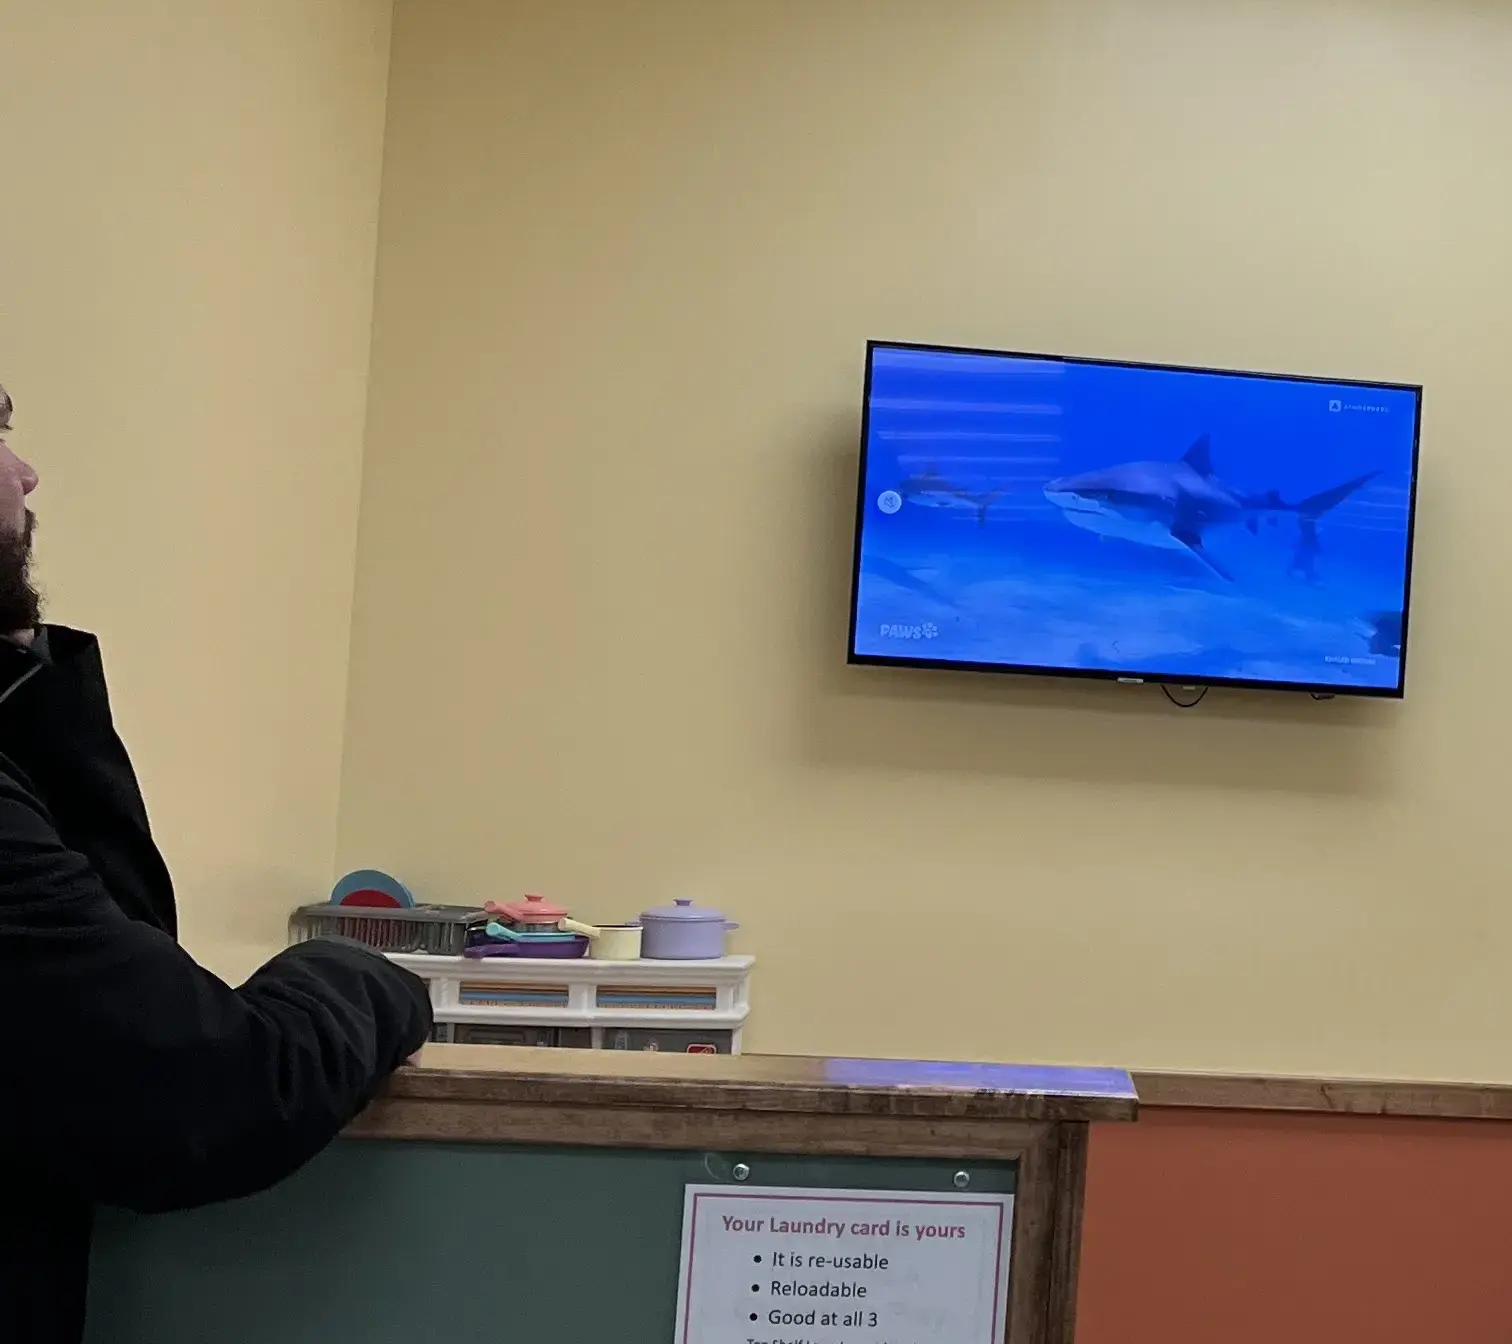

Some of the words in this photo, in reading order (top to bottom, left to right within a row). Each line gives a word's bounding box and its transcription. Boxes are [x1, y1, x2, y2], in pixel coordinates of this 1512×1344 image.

[880, 623, 922, 639] PAWS
[722, 1215, 764, 1232] Your
[770, 1217, 845, 1239] Laundry
[850, 1220, 890, 1237] card
[896, 1220, 910, 1237] is
[915, 1223, 966, 1242] yours
[772, 1251, 785, 1267] It
[790, 1251, 803, 1268] is
[808, 1253, 889, 1270] re-usable
[770, 1280, 868, 1298] Reloadable
[768, 1309, 815, 1326] Good
[820, 1312, 838, 1326] at
[843, 1311, 863, 1327] all
[867, 1312, 878, 1328] 3
